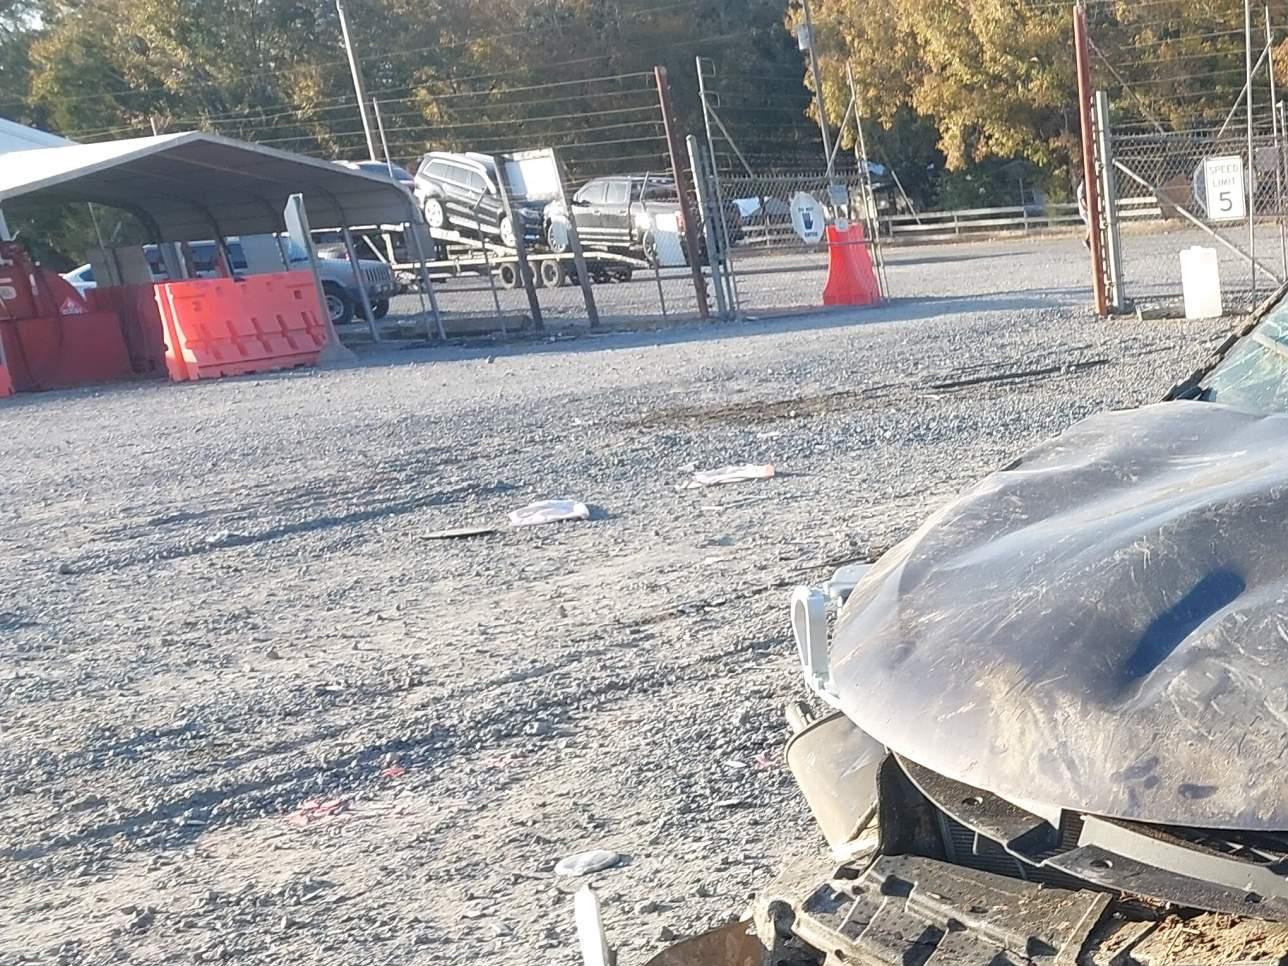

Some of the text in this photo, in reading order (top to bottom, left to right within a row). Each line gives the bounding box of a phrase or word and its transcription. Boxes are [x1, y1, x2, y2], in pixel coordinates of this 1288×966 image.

[1208, 163, 1239, 174] SPEED
[1212, 177, 1236, 188] LIMIT
[1219, 191, 1233, 212] 5
